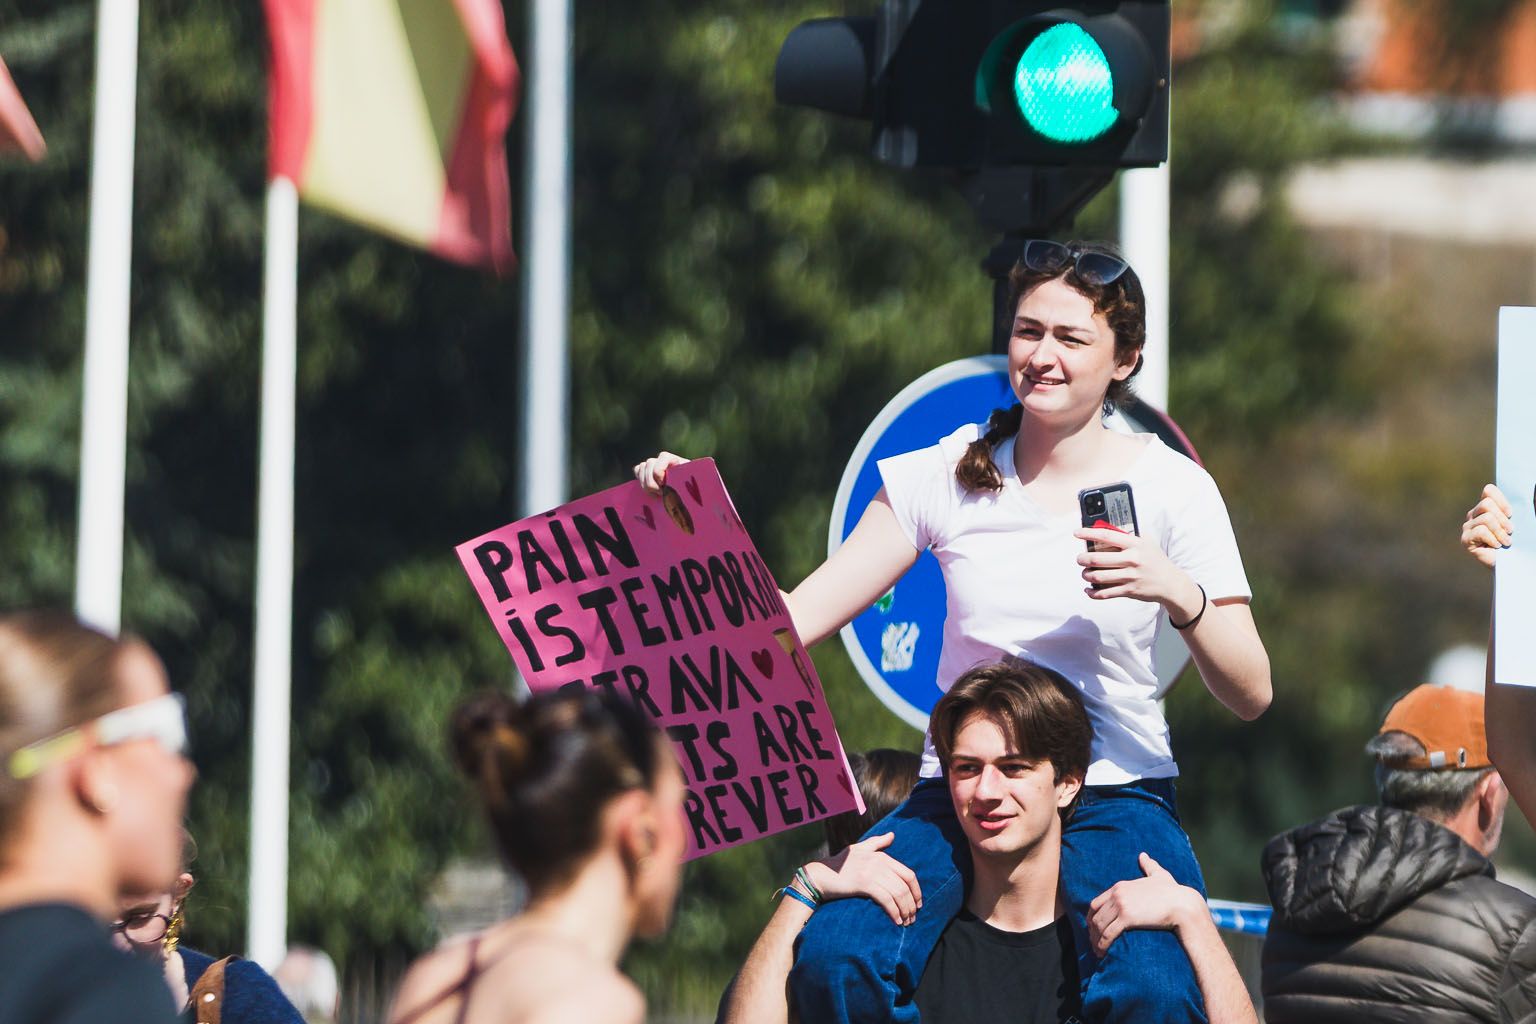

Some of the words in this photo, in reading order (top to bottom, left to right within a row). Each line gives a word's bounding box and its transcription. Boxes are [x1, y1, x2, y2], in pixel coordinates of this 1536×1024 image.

[473, 505, 640, 603] PAIN
[505, 603, 586, 673] IS
[752, 700, 835, 768] ARE
[683, 763, 828, 849] REVER
